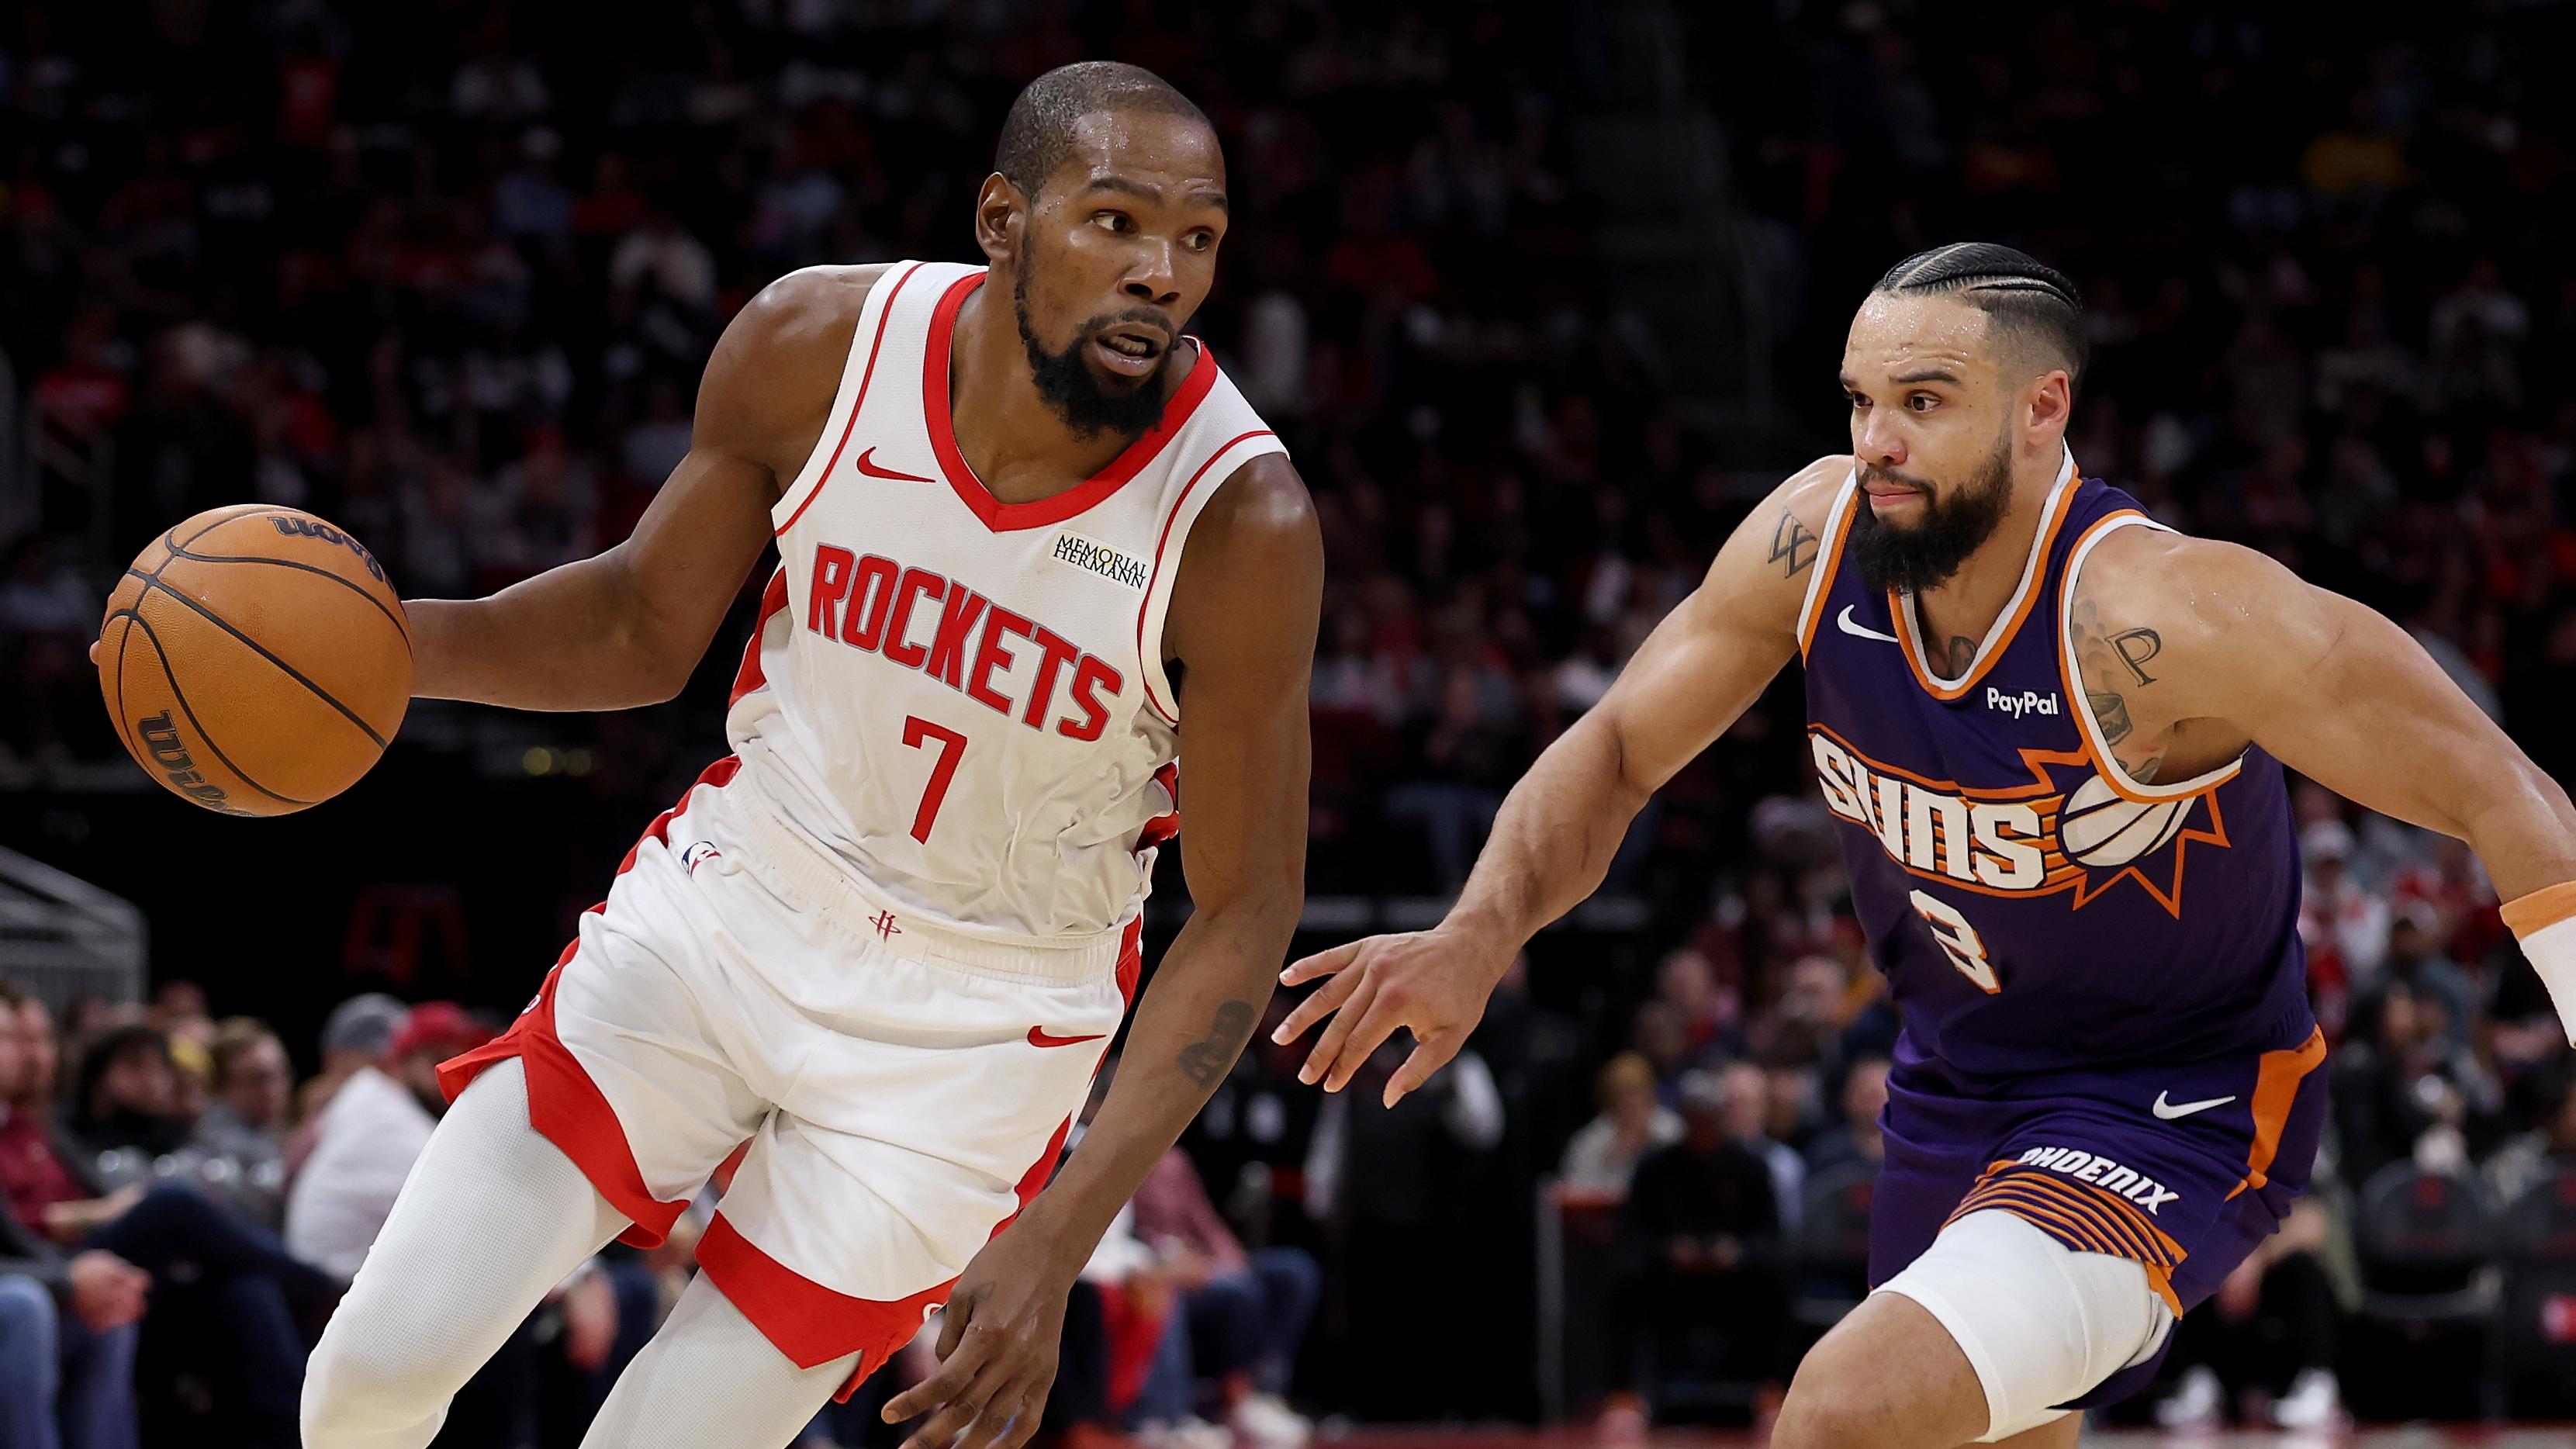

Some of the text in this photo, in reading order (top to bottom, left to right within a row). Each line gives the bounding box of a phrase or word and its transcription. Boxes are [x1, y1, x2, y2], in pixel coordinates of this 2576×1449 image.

[1053, 544, 1146, 590] HERMANN
[1056, 534, 1146, 577] MEMORIAL
[807, 542, 1125, 742] ROCKETS
[2104, 628, 2162, 688] P
[1987, 686, 2059, 719] PayPal
[902, 714, 968, 846] 7
[1812, 733, 2045, 890] SUNS
[1909, 889, 2002, 995] 3
[2017, 1146, 2180, 1216] PHOENIX
